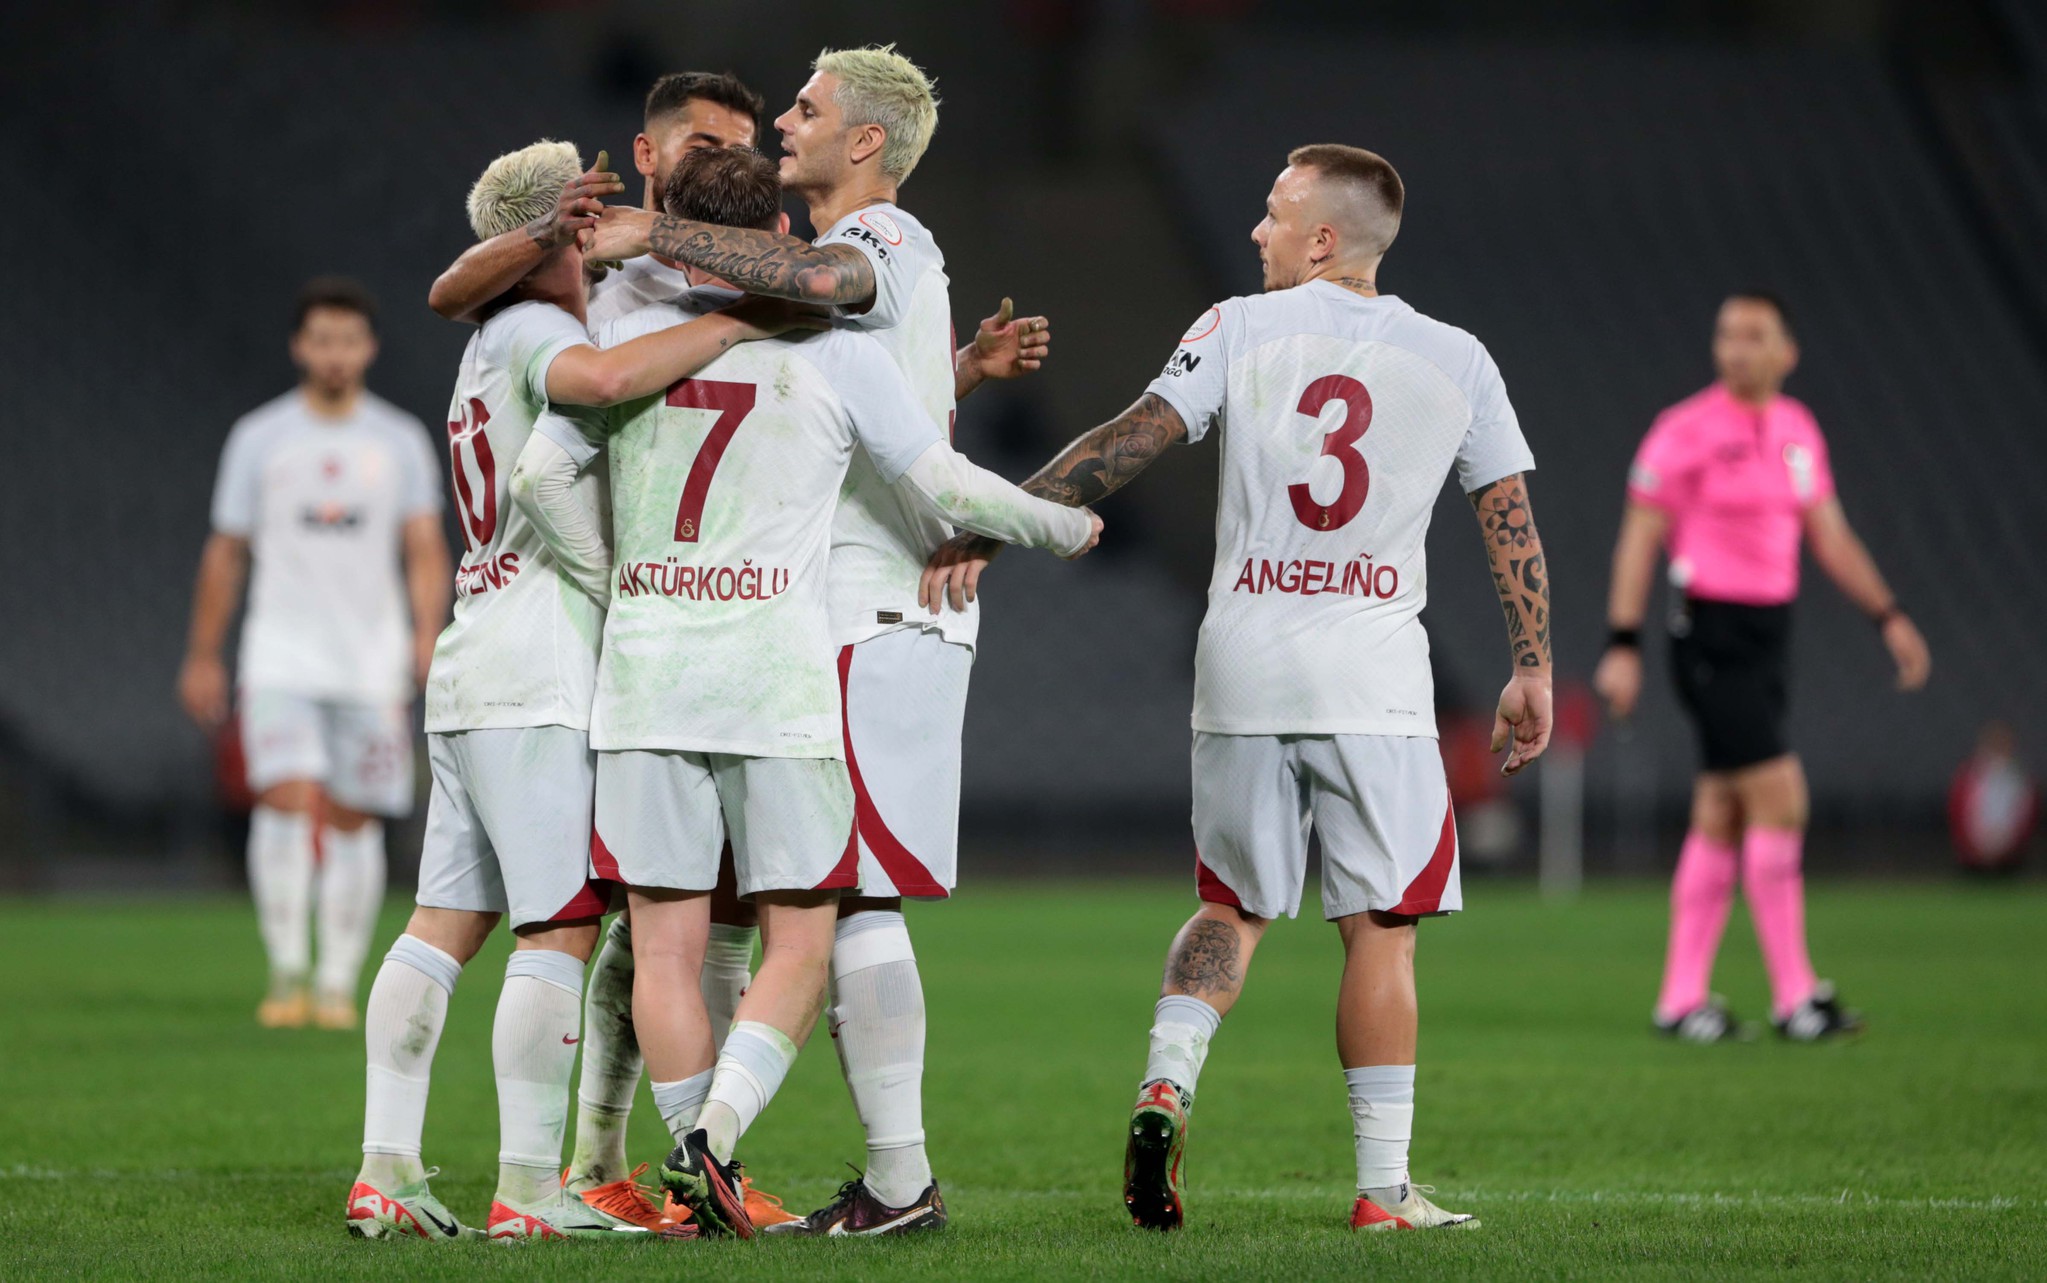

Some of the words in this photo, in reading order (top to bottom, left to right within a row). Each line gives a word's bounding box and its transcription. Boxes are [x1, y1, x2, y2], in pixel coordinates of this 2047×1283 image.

[665, 378, 757, 543] 7
[1287, 374, 1373, 531] 3
[619, 556, 789, 601] AKTÜRKOĞLU
[1233, 552, 1398, 599] ANGELIÑO
